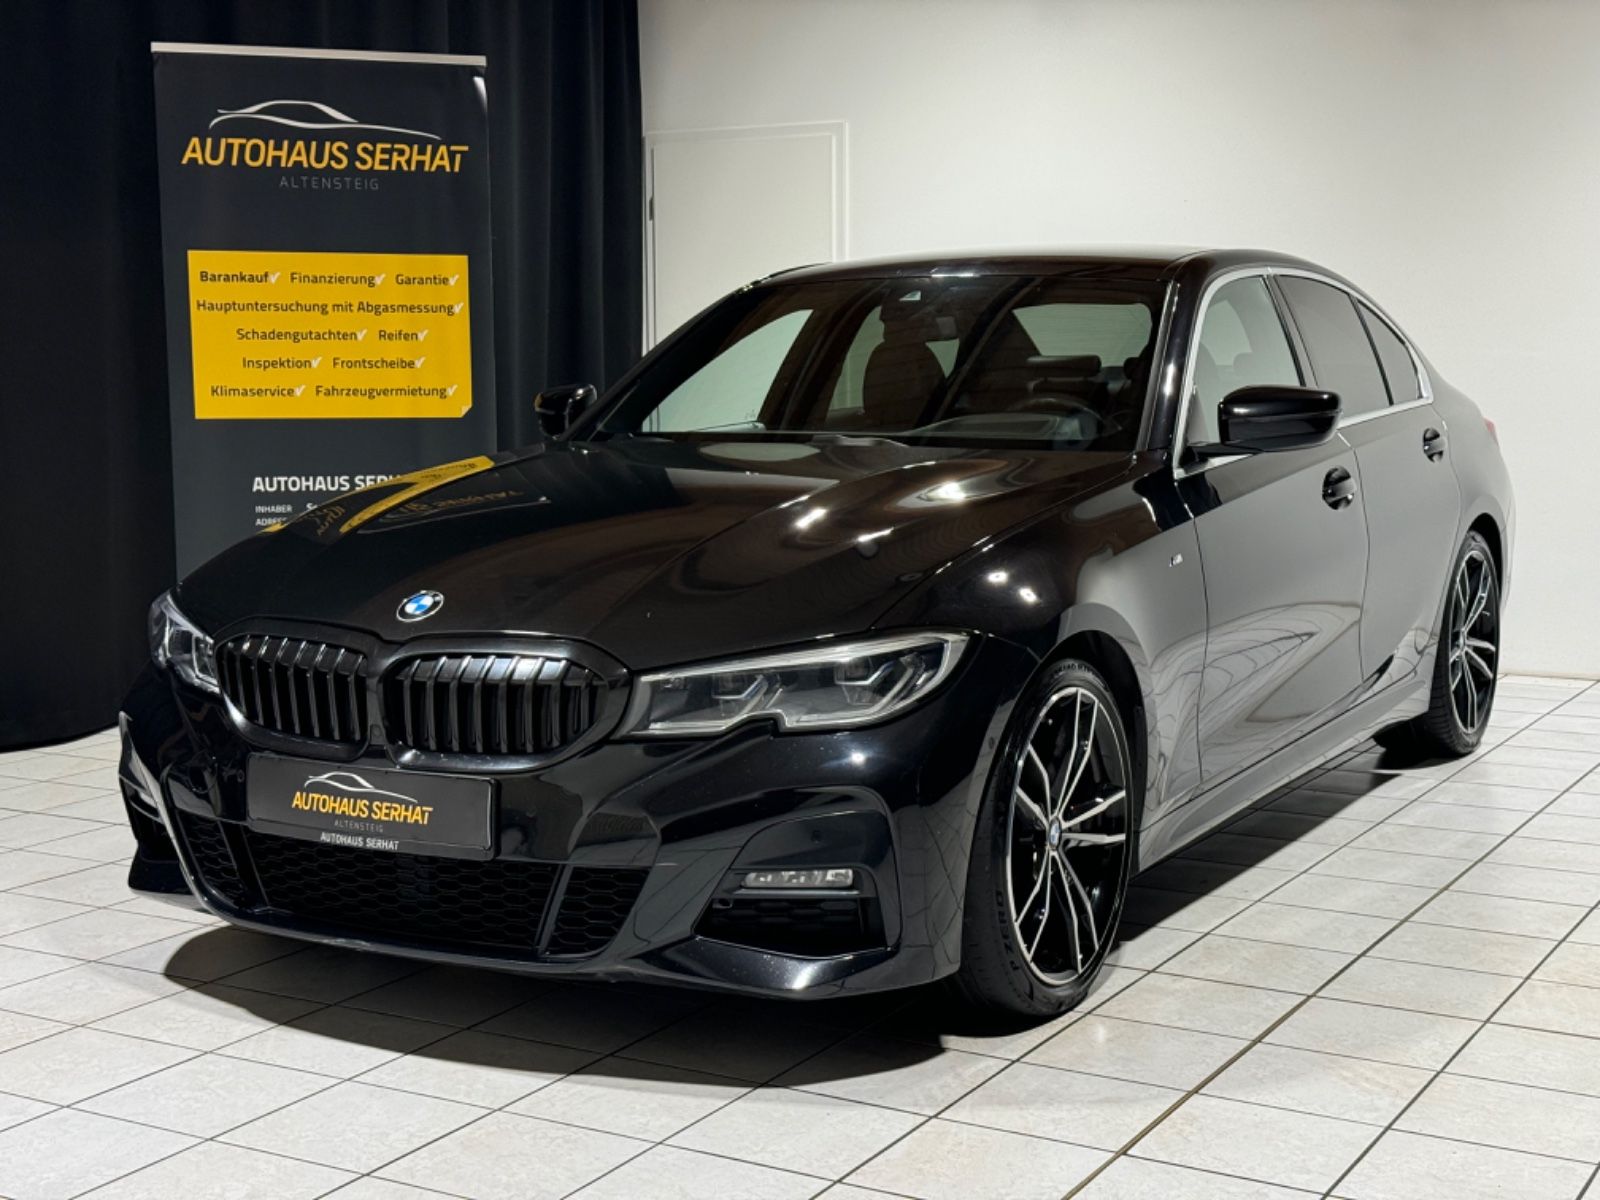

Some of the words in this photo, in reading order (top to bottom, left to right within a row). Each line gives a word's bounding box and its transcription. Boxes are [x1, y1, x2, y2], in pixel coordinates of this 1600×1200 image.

[181, 137, 348, 168] AUTOHAUS
[355, 142, 469, 173] SERHAT
[279, 176, 379, 190] ALTENSTEIG
[199, 271, 268, 284] Barankauf
[290, 272, 375, 287] Finanzierung
[395, 274, 449, 286] Garantie
[196, 299, 328, 315] Hauptuntersuchung
[332, 303, 353, 313] mit
[357, 303, 454, 317] Abgasmessung
[236, 328, 357, 343] Schadengutachten
[378, 329, 418, 341] Reifen
[242, 357, 311, 371] Inspektion
[332, 357, 415, 369] Frontscheibe
[211, 385, 294, 397] Klimaservice
[315, 385, 447, 399] Fahrzeugvermietung
[252, 475, 350, 492] AUTOHAUS
[255, 504, 292, 514] INHABER
[292, 791, 369, 818] AUTOHAUS
[371, 802, 433, 825] SERHAT
[334, 820, 384, 833] ALTENSTEIG
[320, 832, 364, 847] AUTOHAUS
[366, 837, 399, 850] SERHAT
